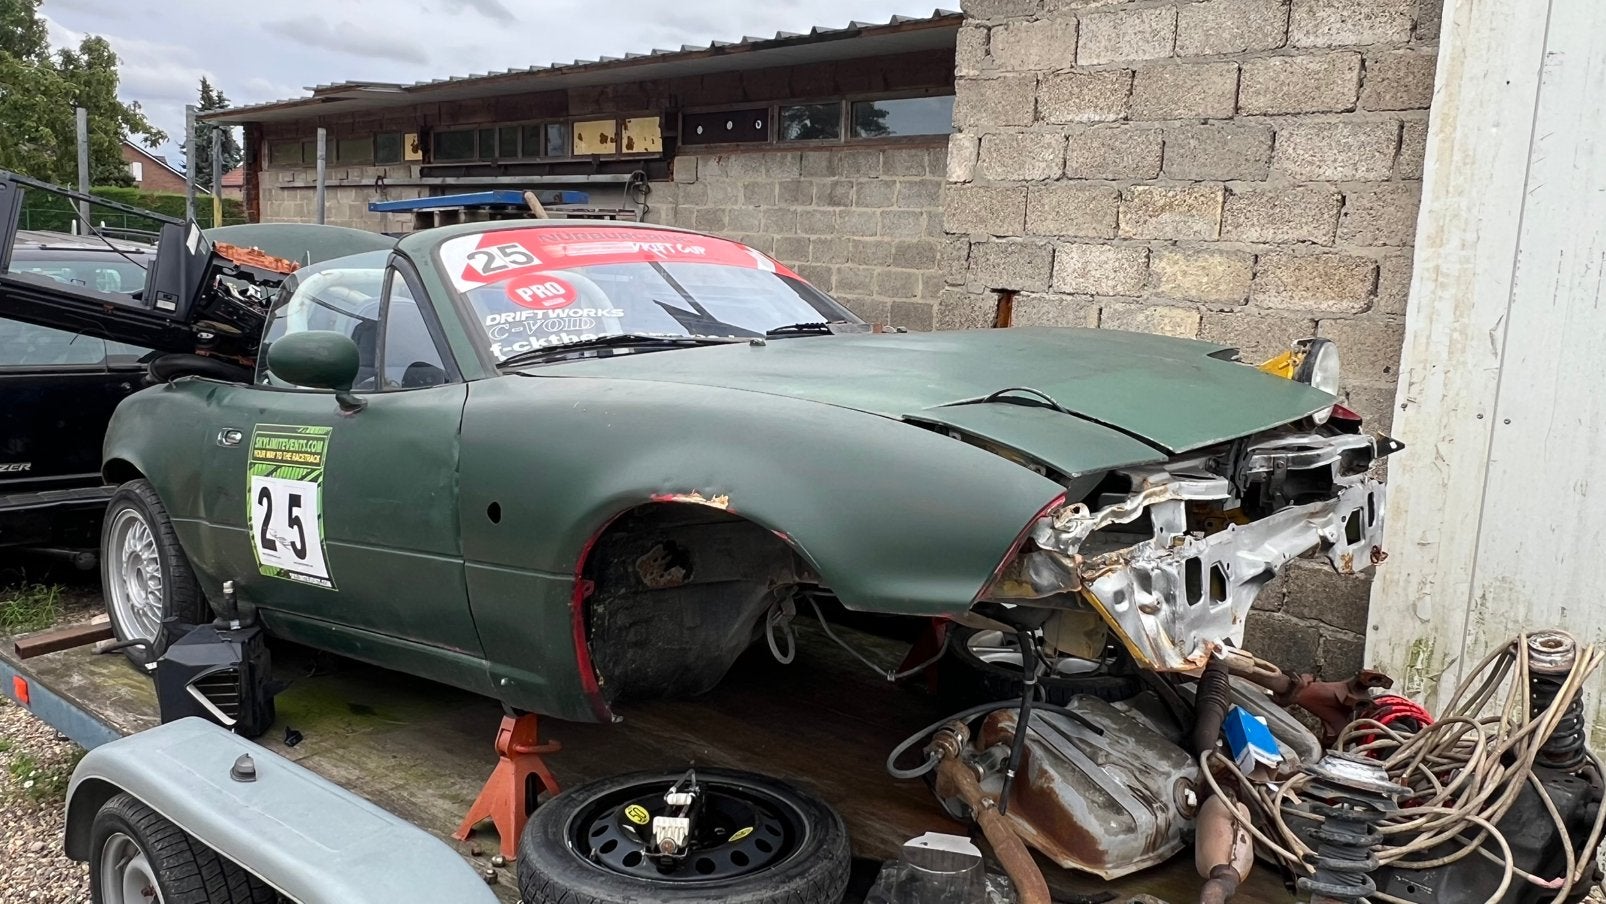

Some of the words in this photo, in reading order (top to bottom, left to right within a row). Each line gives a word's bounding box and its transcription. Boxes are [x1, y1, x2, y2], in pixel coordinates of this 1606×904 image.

[467, 244, 534, 274] 25
[515, 281, 566, 302] PRO
[486, 308, 625, 326] DRIFTWORKS
[489, 317, 596, 340] C-VOID
[254, 437, 323, 452] SKYLIMITEVENTS.COM
